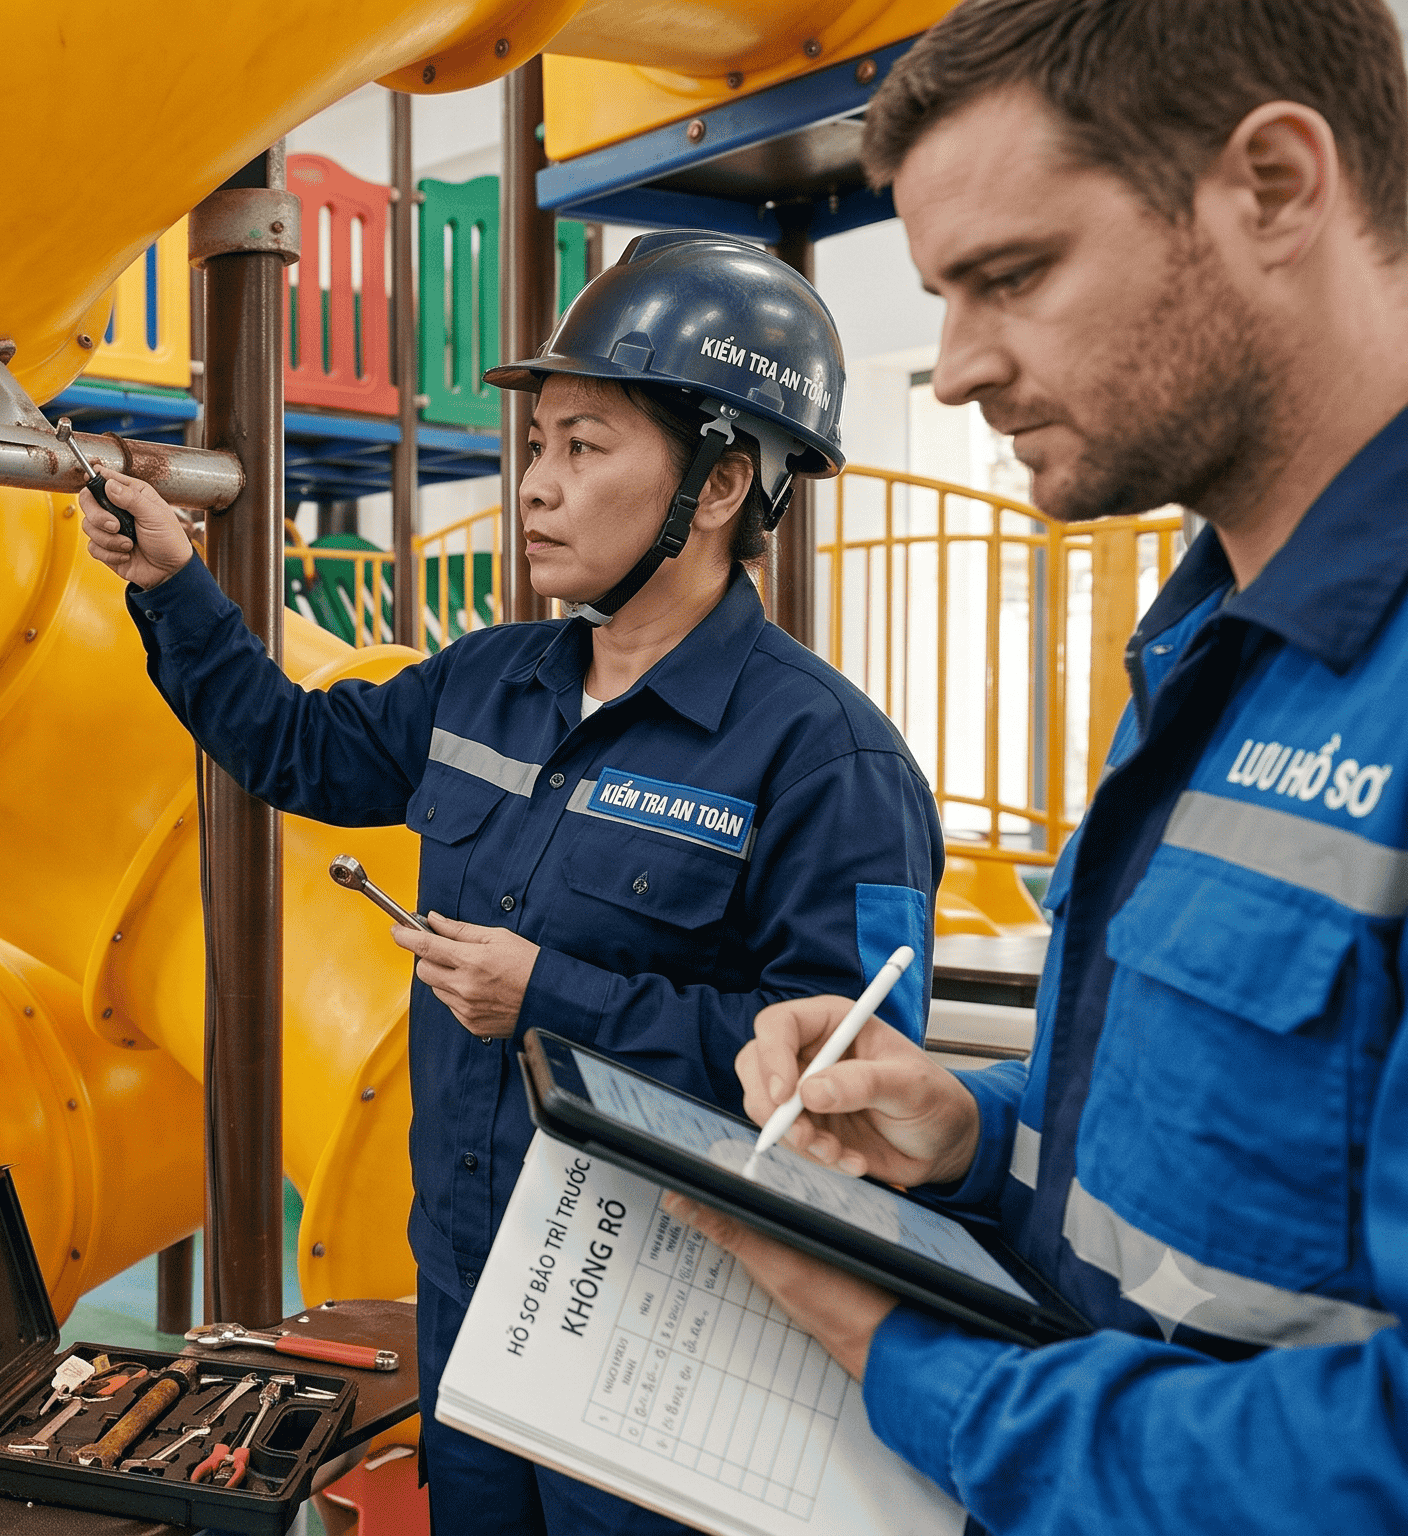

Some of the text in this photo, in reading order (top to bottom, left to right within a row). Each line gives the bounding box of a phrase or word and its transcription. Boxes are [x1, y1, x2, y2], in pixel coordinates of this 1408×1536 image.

[748, 352, 778, 381] TRA
[779, 367, 801, 391] AN
[1324, 758, 1393, 818] SƠ
[639, 792, 668, 815] TRA
[667, 798, 696, 822] AN
[696, 804, 744, 838] TOÀN
[561, 1197, 627, 1337] KHÔNG RÕ
[520, 1294, 539, 1324] SƠ
